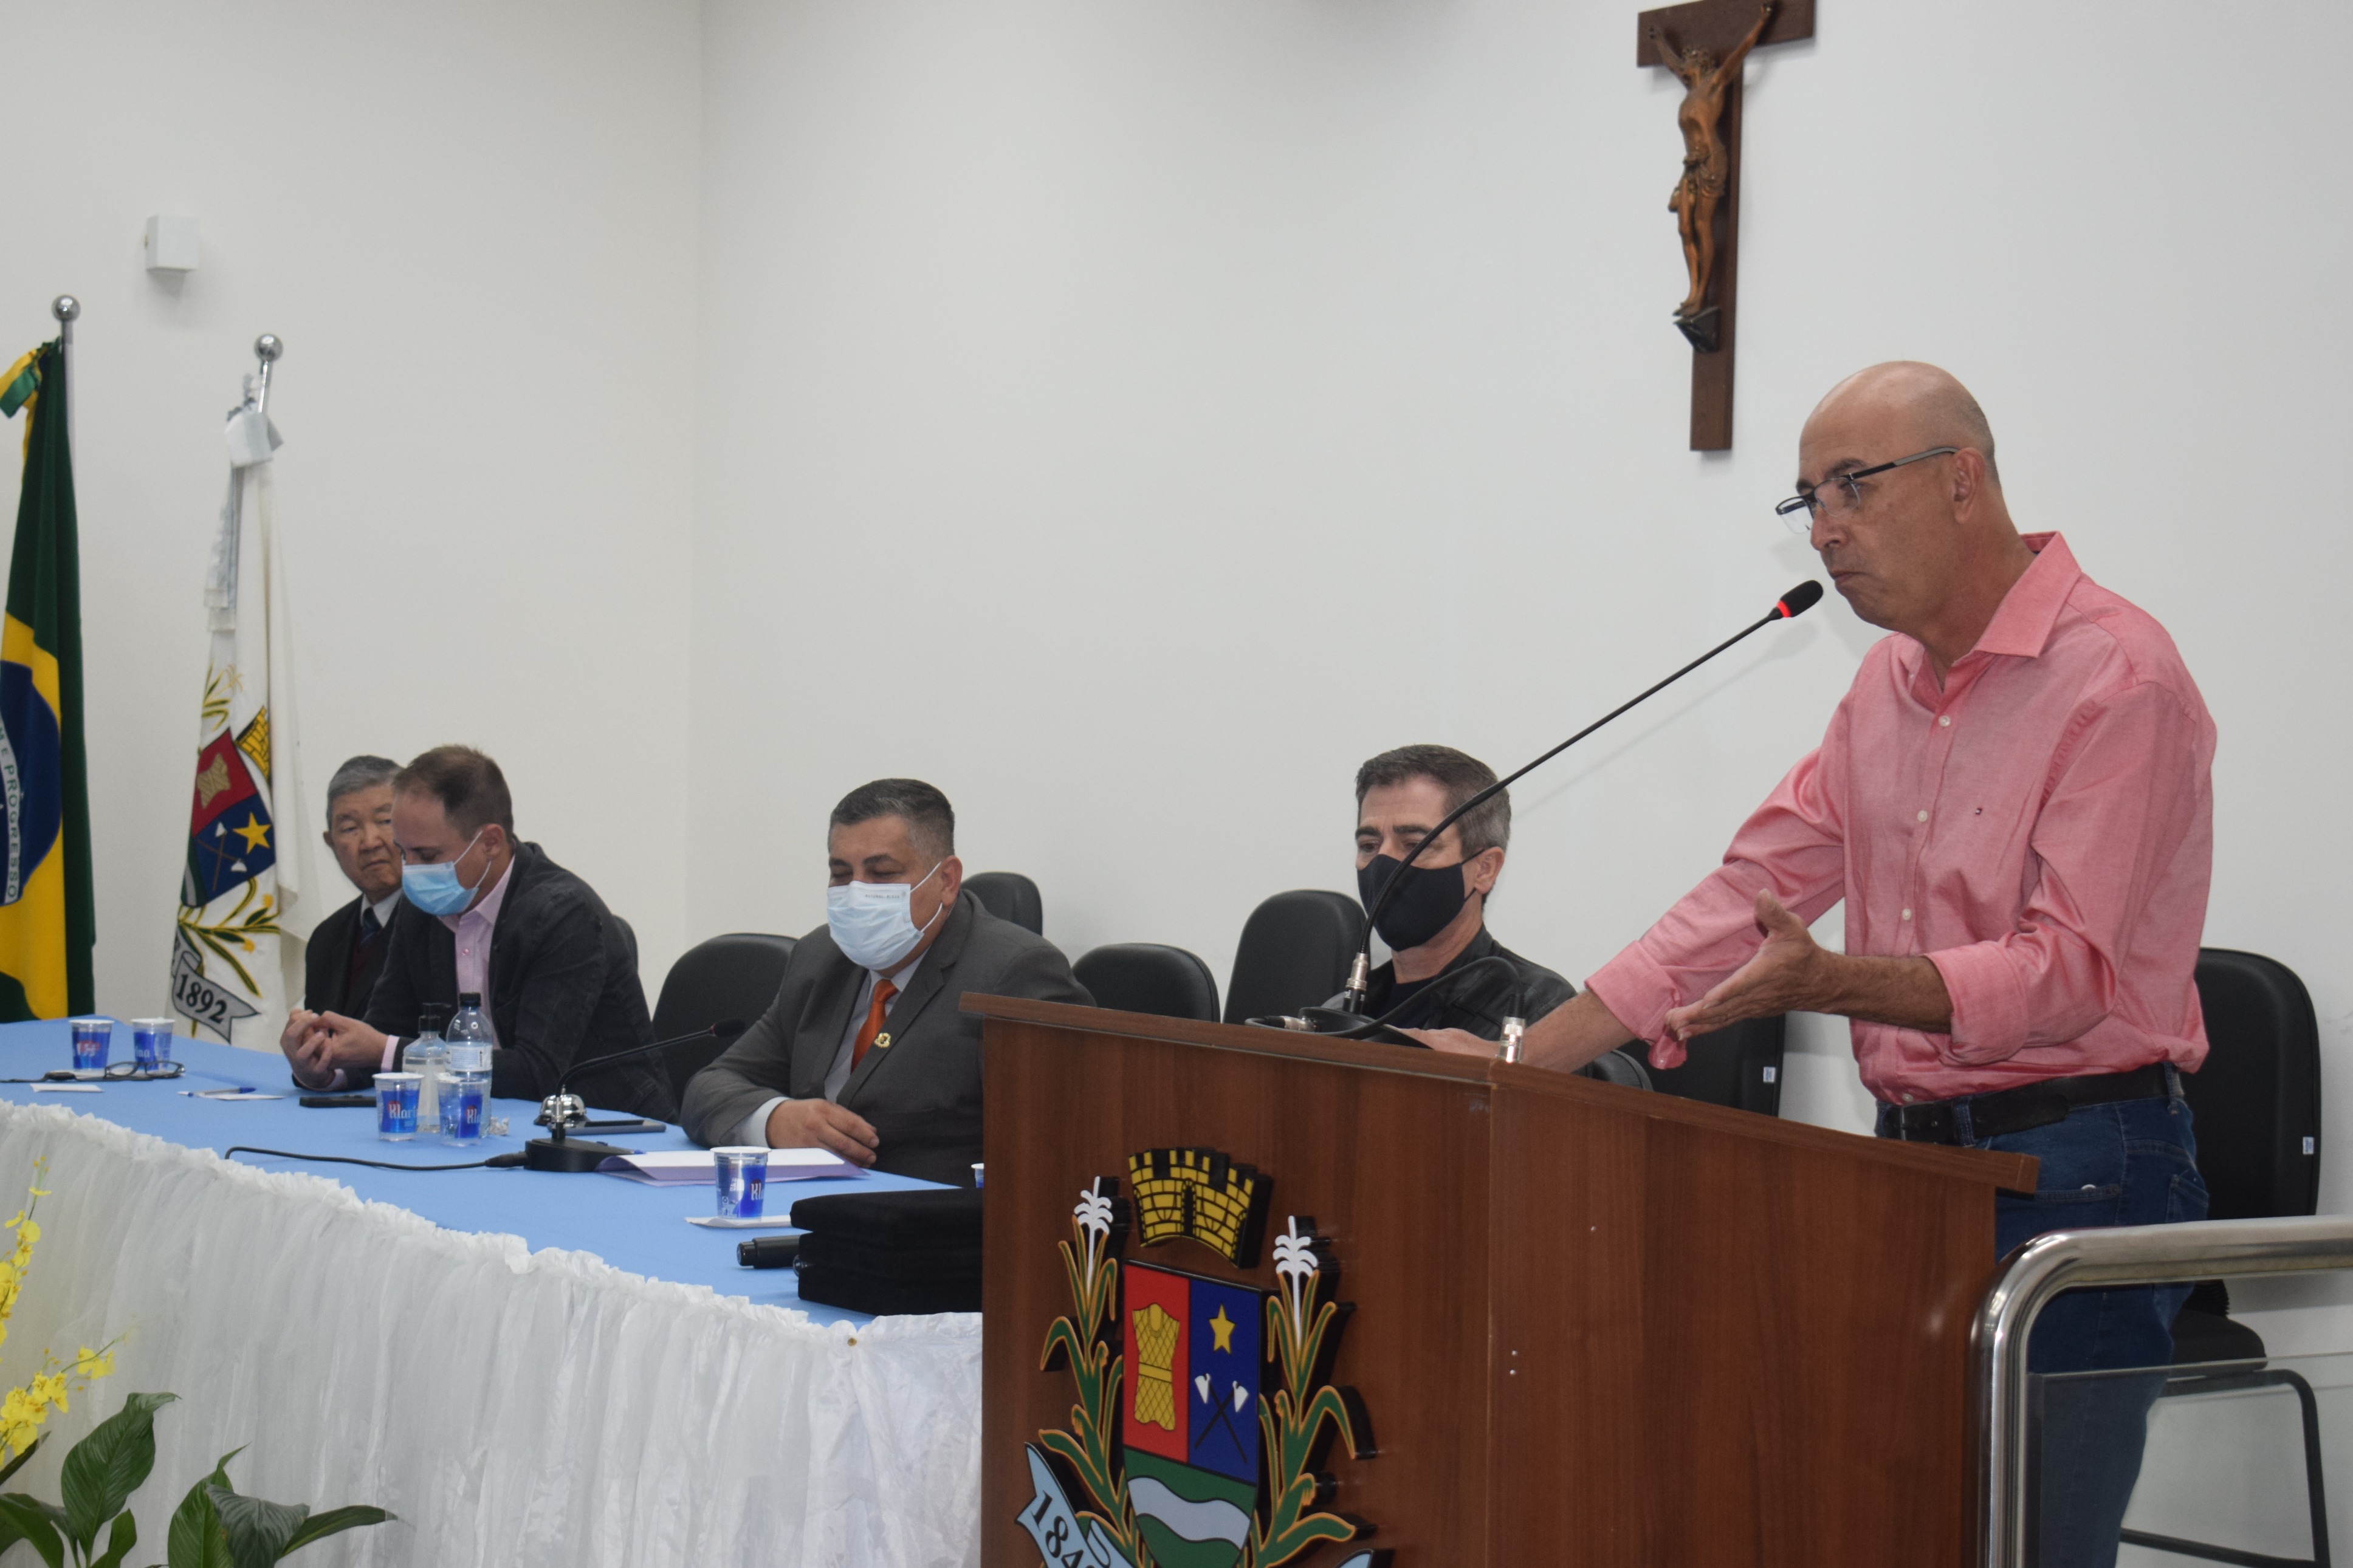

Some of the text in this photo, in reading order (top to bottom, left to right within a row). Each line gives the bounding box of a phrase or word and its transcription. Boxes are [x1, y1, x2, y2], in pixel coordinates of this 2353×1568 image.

[4, 764, 19, 899] PROGRESSO
[176, 974, 227, 1024] 1892
[1030, 1489, 1094, 1568] 184
